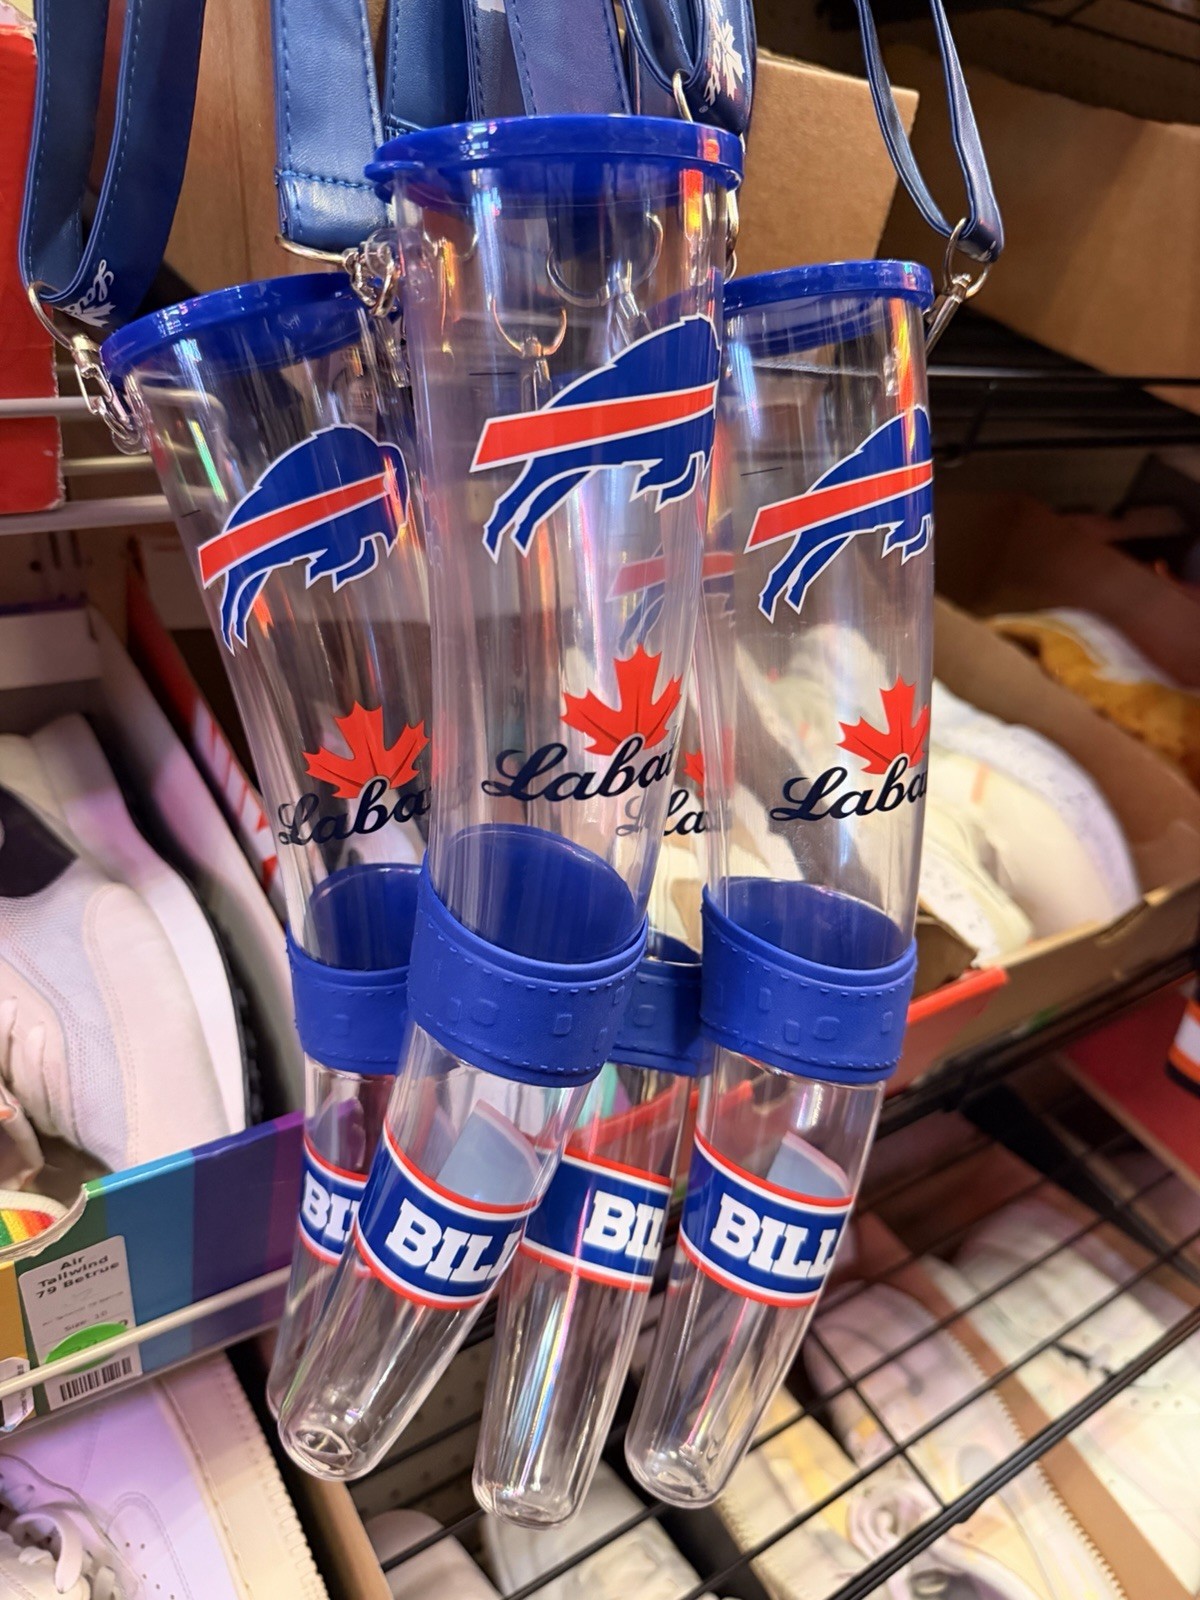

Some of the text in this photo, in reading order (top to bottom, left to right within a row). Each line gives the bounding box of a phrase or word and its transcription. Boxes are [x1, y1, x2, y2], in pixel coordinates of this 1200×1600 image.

[38, 1255, 108, 1288] Tailwind
[61, 1256, 85, 1270] Air
[36, 1262, 119, 1299] 79 Betrue
